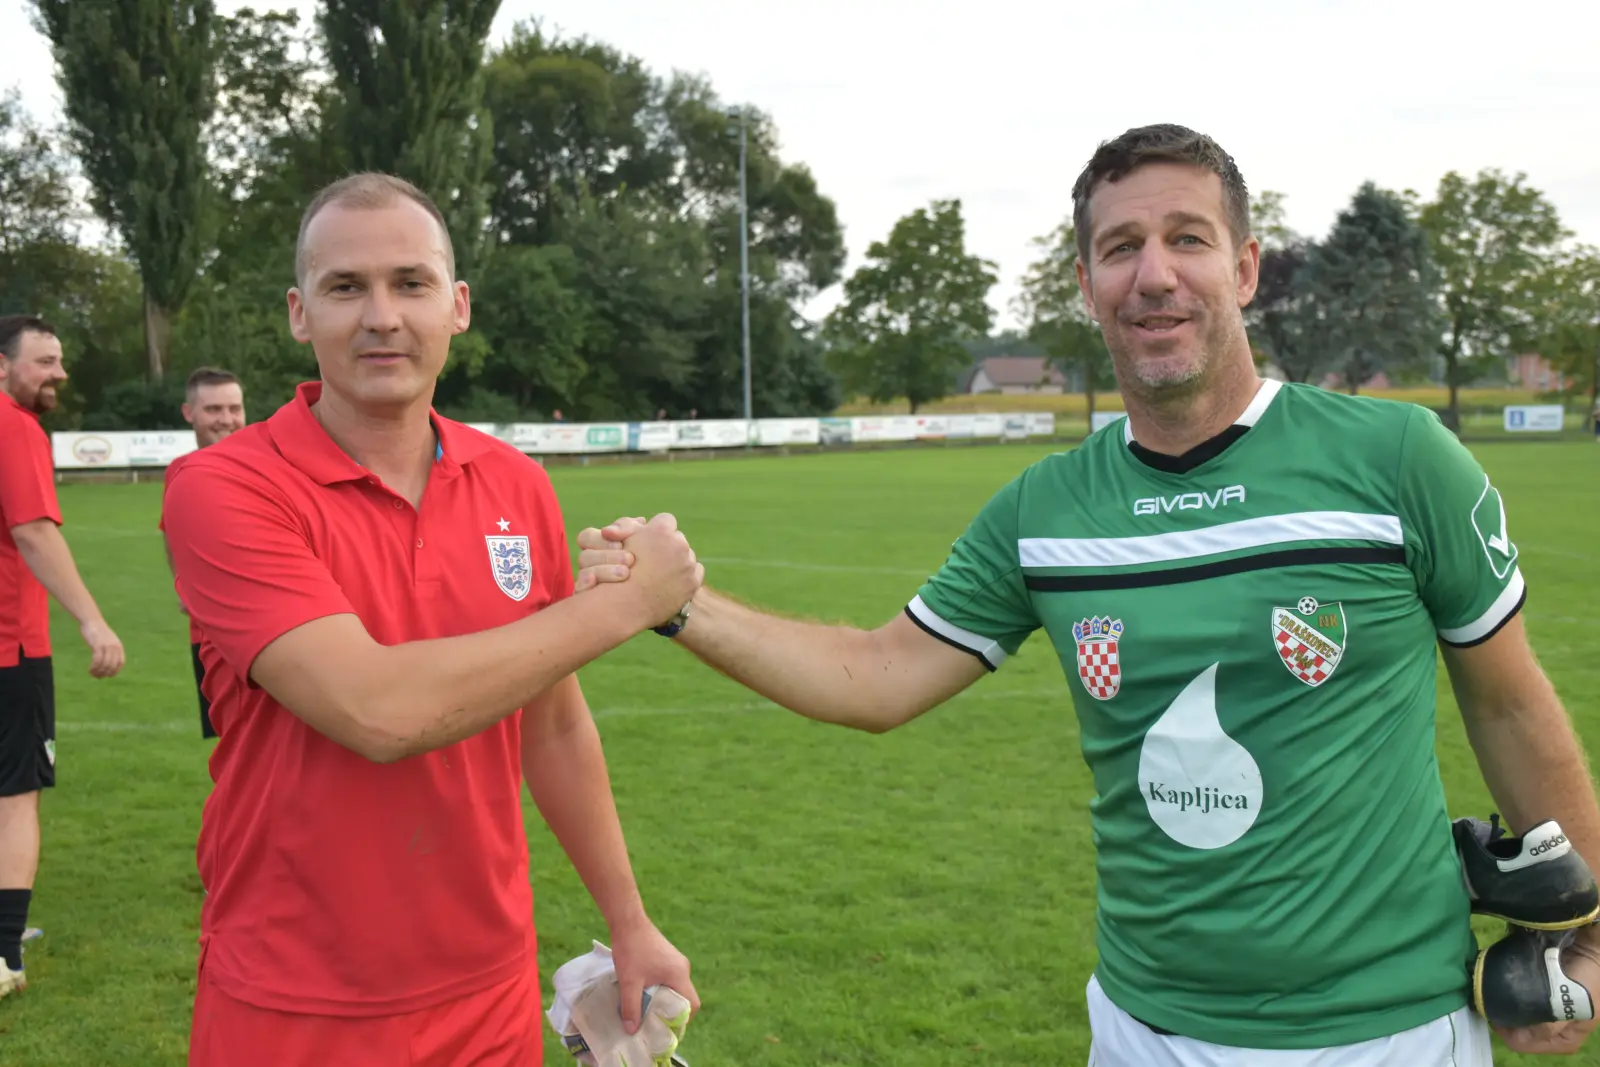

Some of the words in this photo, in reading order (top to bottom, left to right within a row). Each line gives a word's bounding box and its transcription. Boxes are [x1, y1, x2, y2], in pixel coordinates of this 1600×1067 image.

[1133, 484, 1246, 516] GIVOVA
[1318, 613, 1339, 628] NK
[1148, 781, 1248, 814] Kapljica
[1559, 984, 1576, 1021] adida
